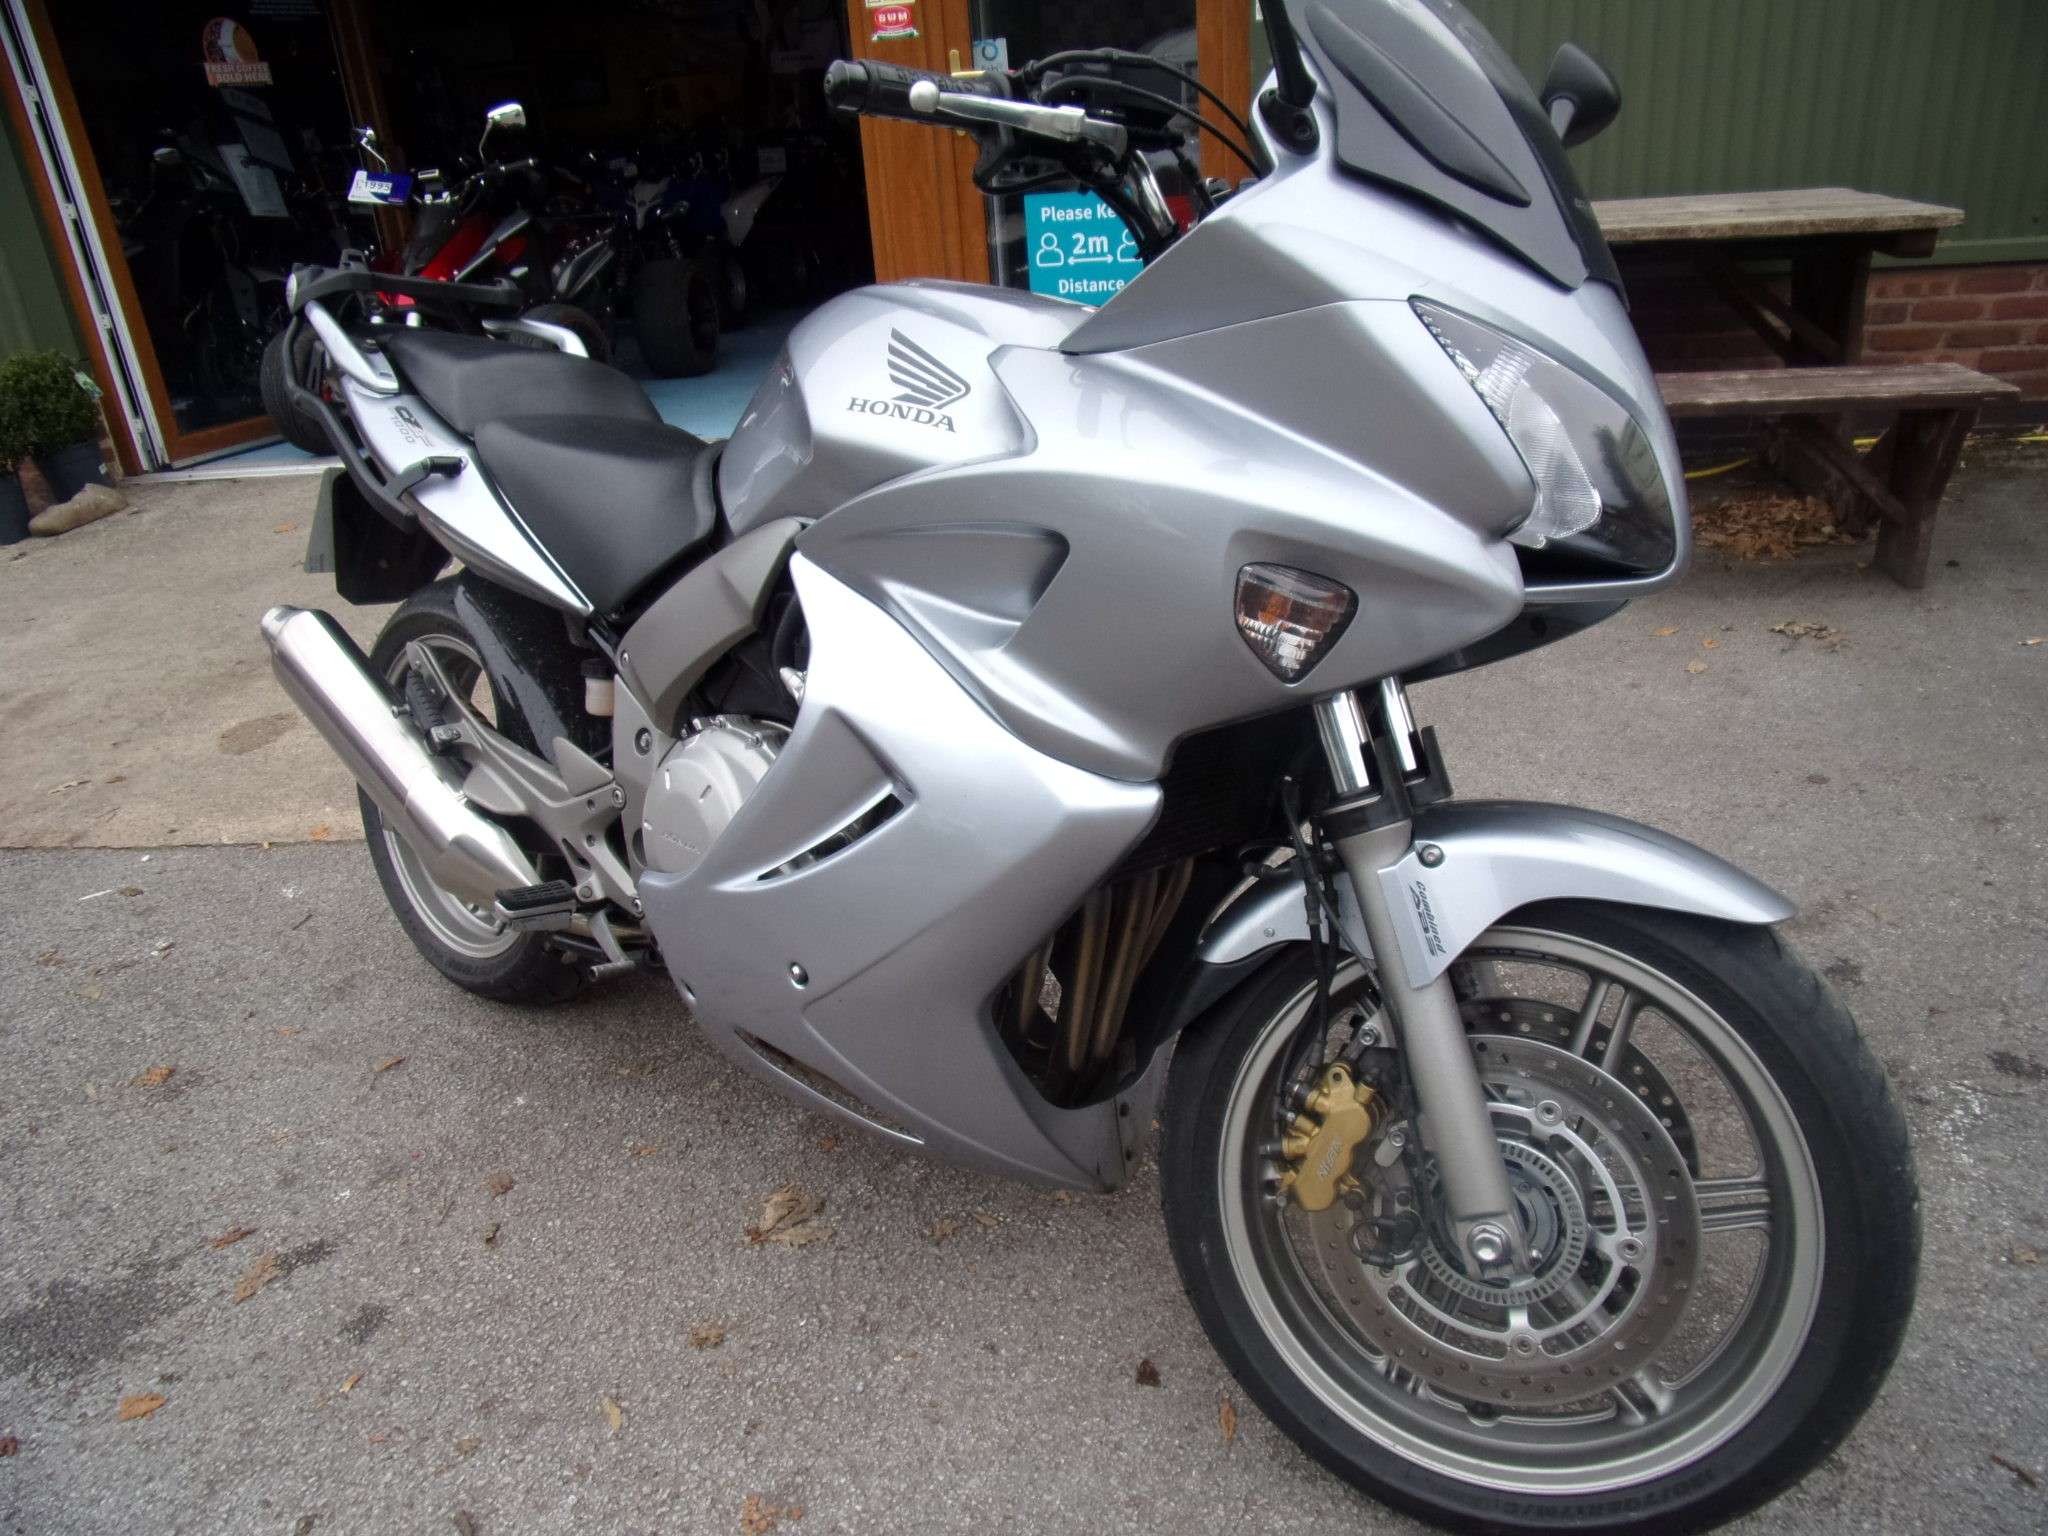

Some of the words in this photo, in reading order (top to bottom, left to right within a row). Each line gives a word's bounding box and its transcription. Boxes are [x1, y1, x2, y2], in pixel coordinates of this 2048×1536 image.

[1041, 205, 1092, 222] Please
[1097, 203, 1117, 219] Ke
[1072, 233, 1109, 254] 2m
[1059, 279, 1125, 293] Distance
[847, 397, 957, 433] HONDA
[1416, 880, 1447, 954] Combined
